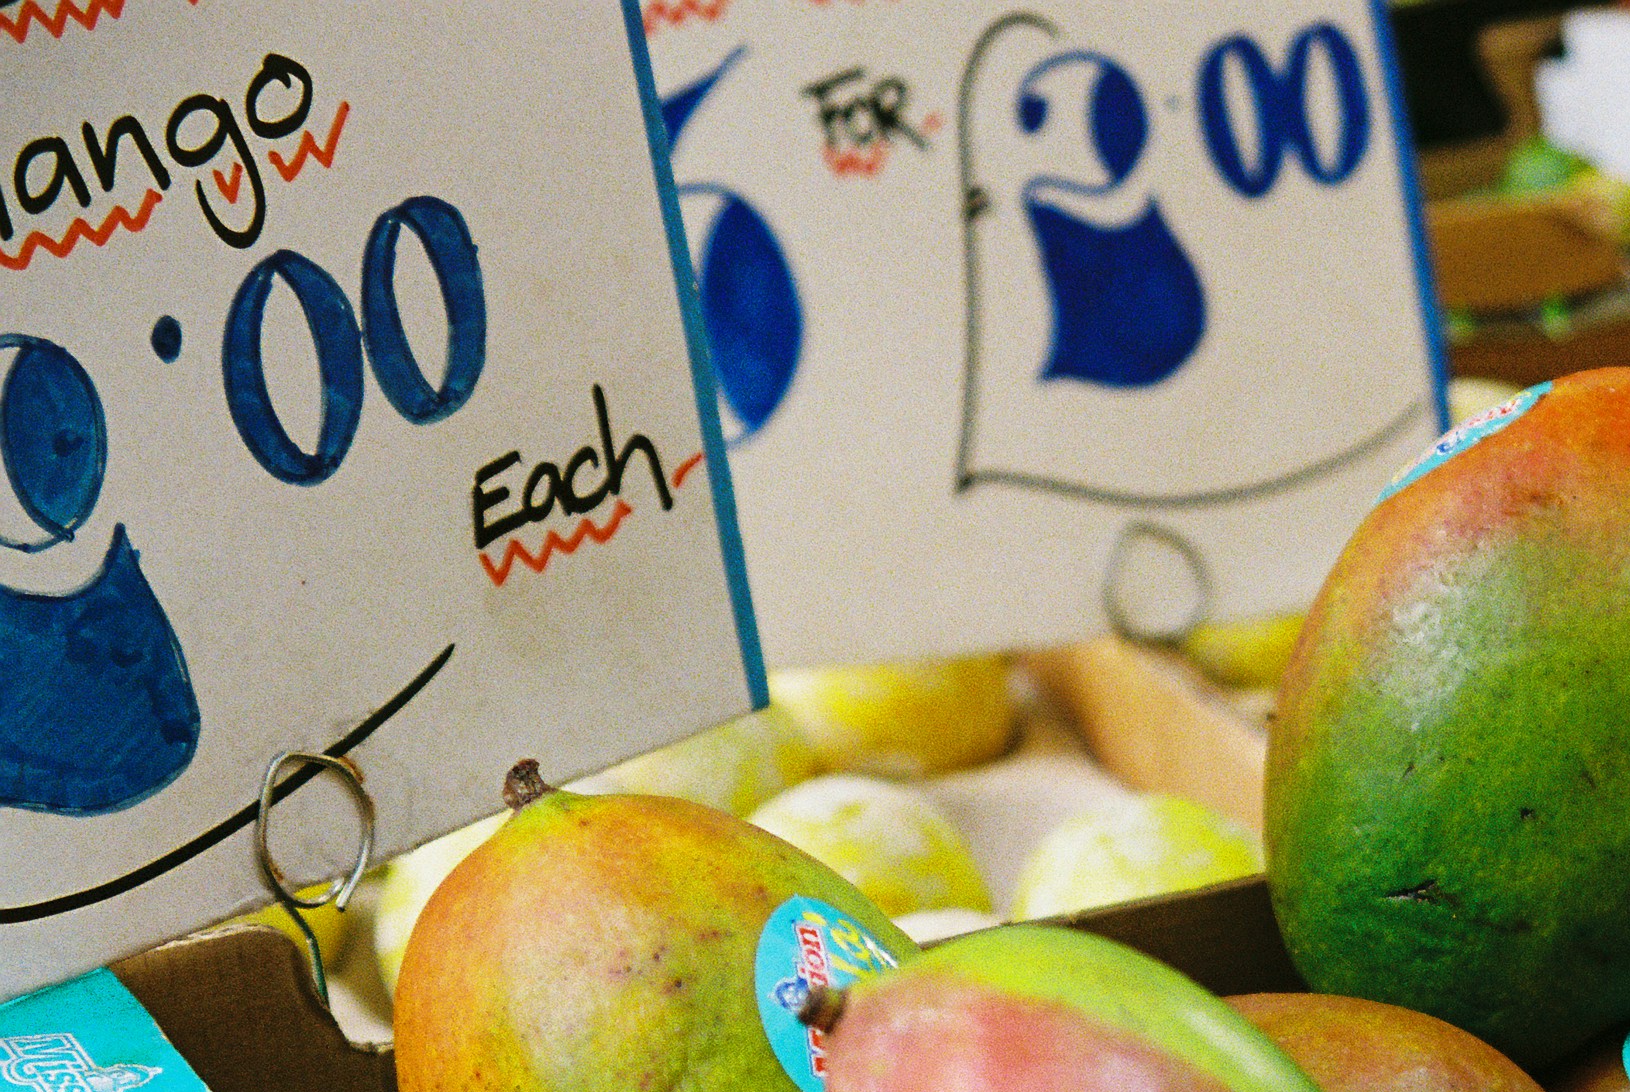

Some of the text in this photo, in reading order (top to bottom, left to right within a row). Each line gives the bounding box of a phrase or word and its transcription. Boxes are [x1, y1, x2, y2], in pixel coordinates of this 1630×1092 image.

[0, 53, 313, 248] ango
[799, 65, 932, 152] FOR
[471, 384, 674, 549] Each
